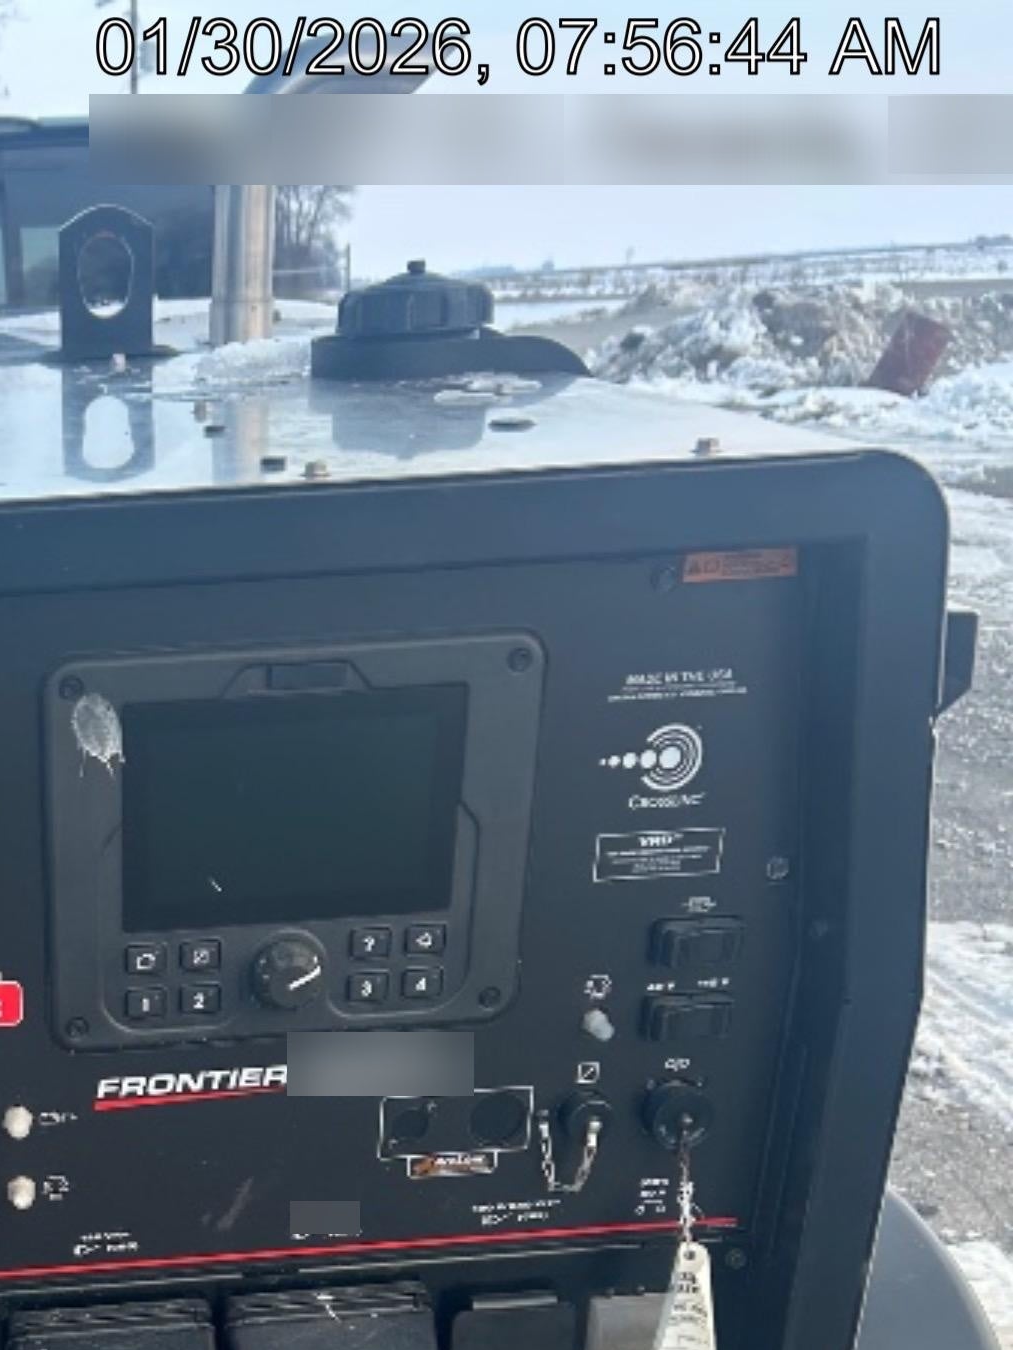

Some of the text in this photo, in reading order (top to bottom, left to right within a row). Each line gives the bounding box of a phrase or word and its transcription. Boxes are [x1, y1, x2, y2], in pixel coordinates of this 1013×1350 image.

[360, 979, 373, 998] 3
[414, 976, 427, 992] 4
[192, 992, 205, 1010] 2
[96, 1064, 287, 1098] FRONTIER
